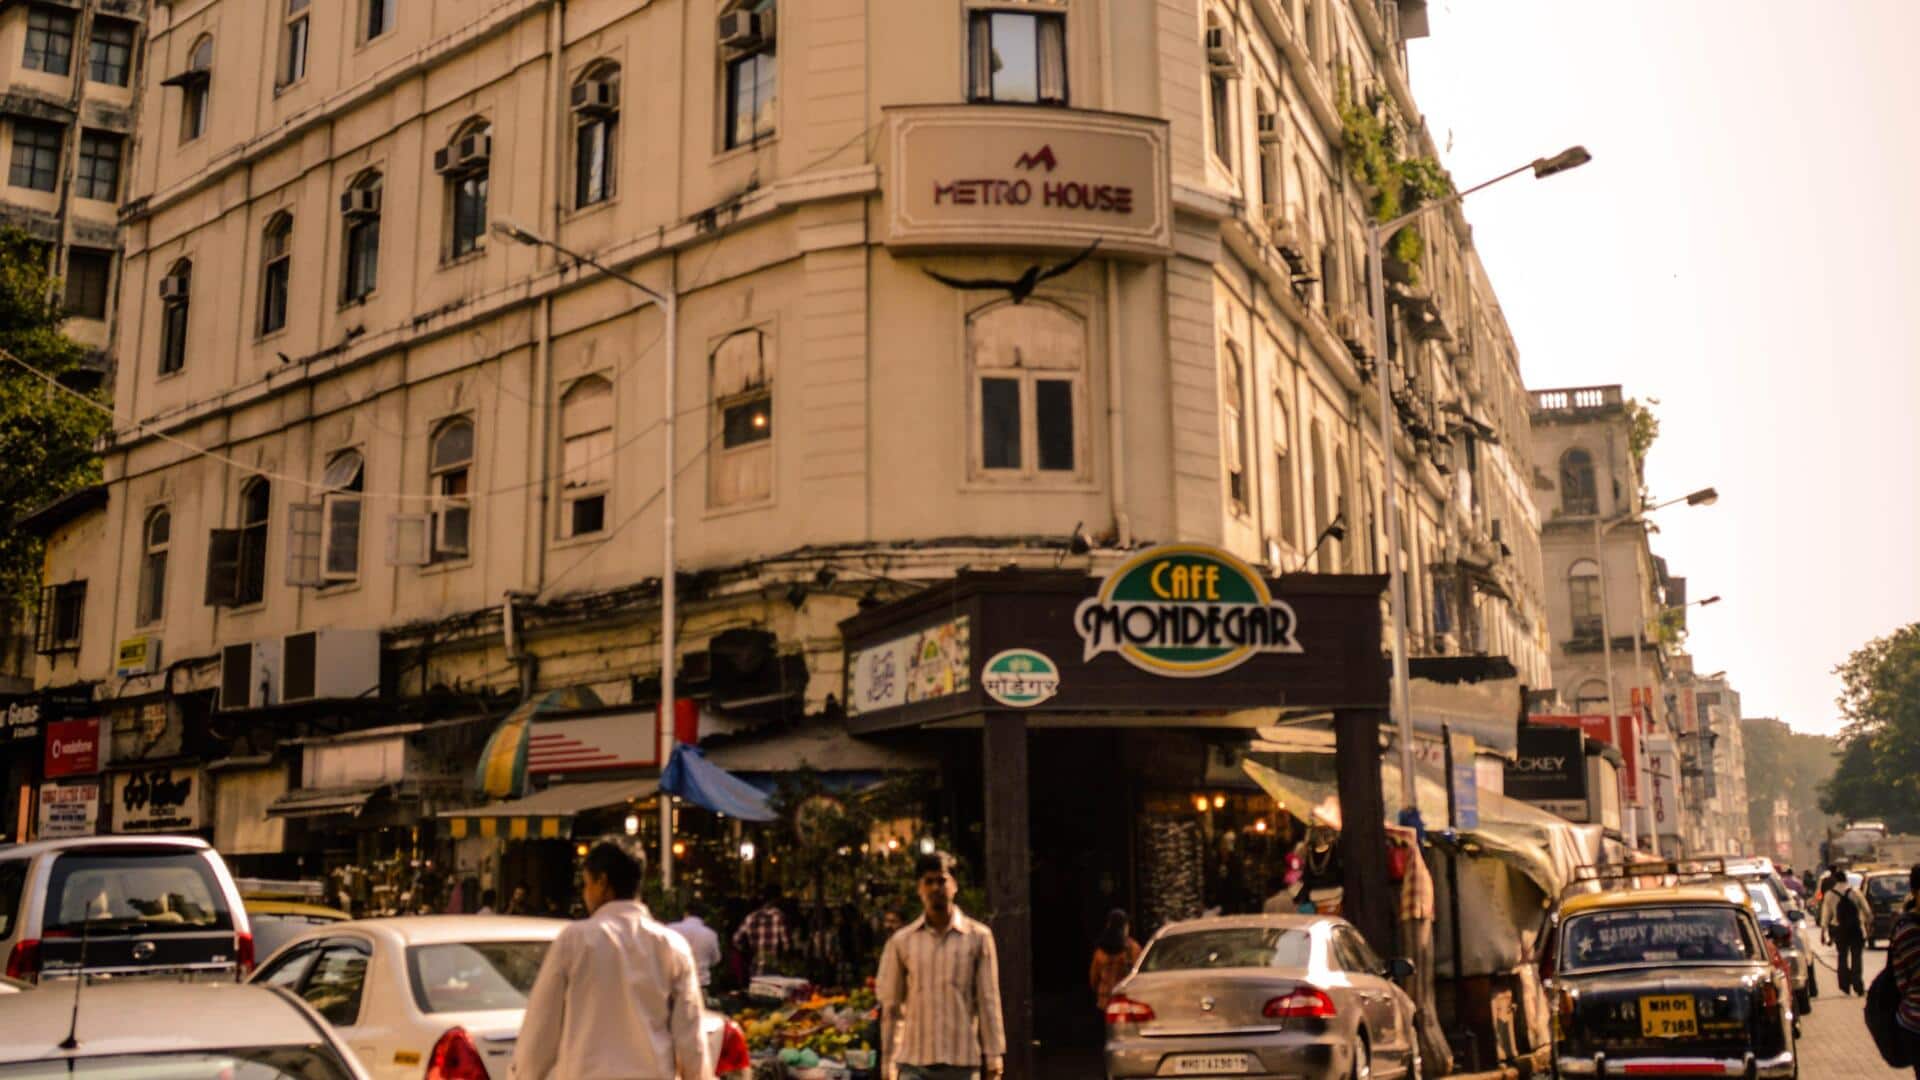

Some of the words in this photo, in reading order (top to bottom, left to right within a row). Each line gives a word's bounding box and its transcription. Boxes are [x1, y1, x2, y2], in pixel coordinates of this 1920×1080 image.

[934, 179, 1031, 205] METRO
[1043, 183, 1134, 214] HOUSE
[1150, 561, 1221, 600] CAFE
[1082, 604, 1291, 647] MONDEGAR
[1505, 755, 1566, 773] OCKEY
